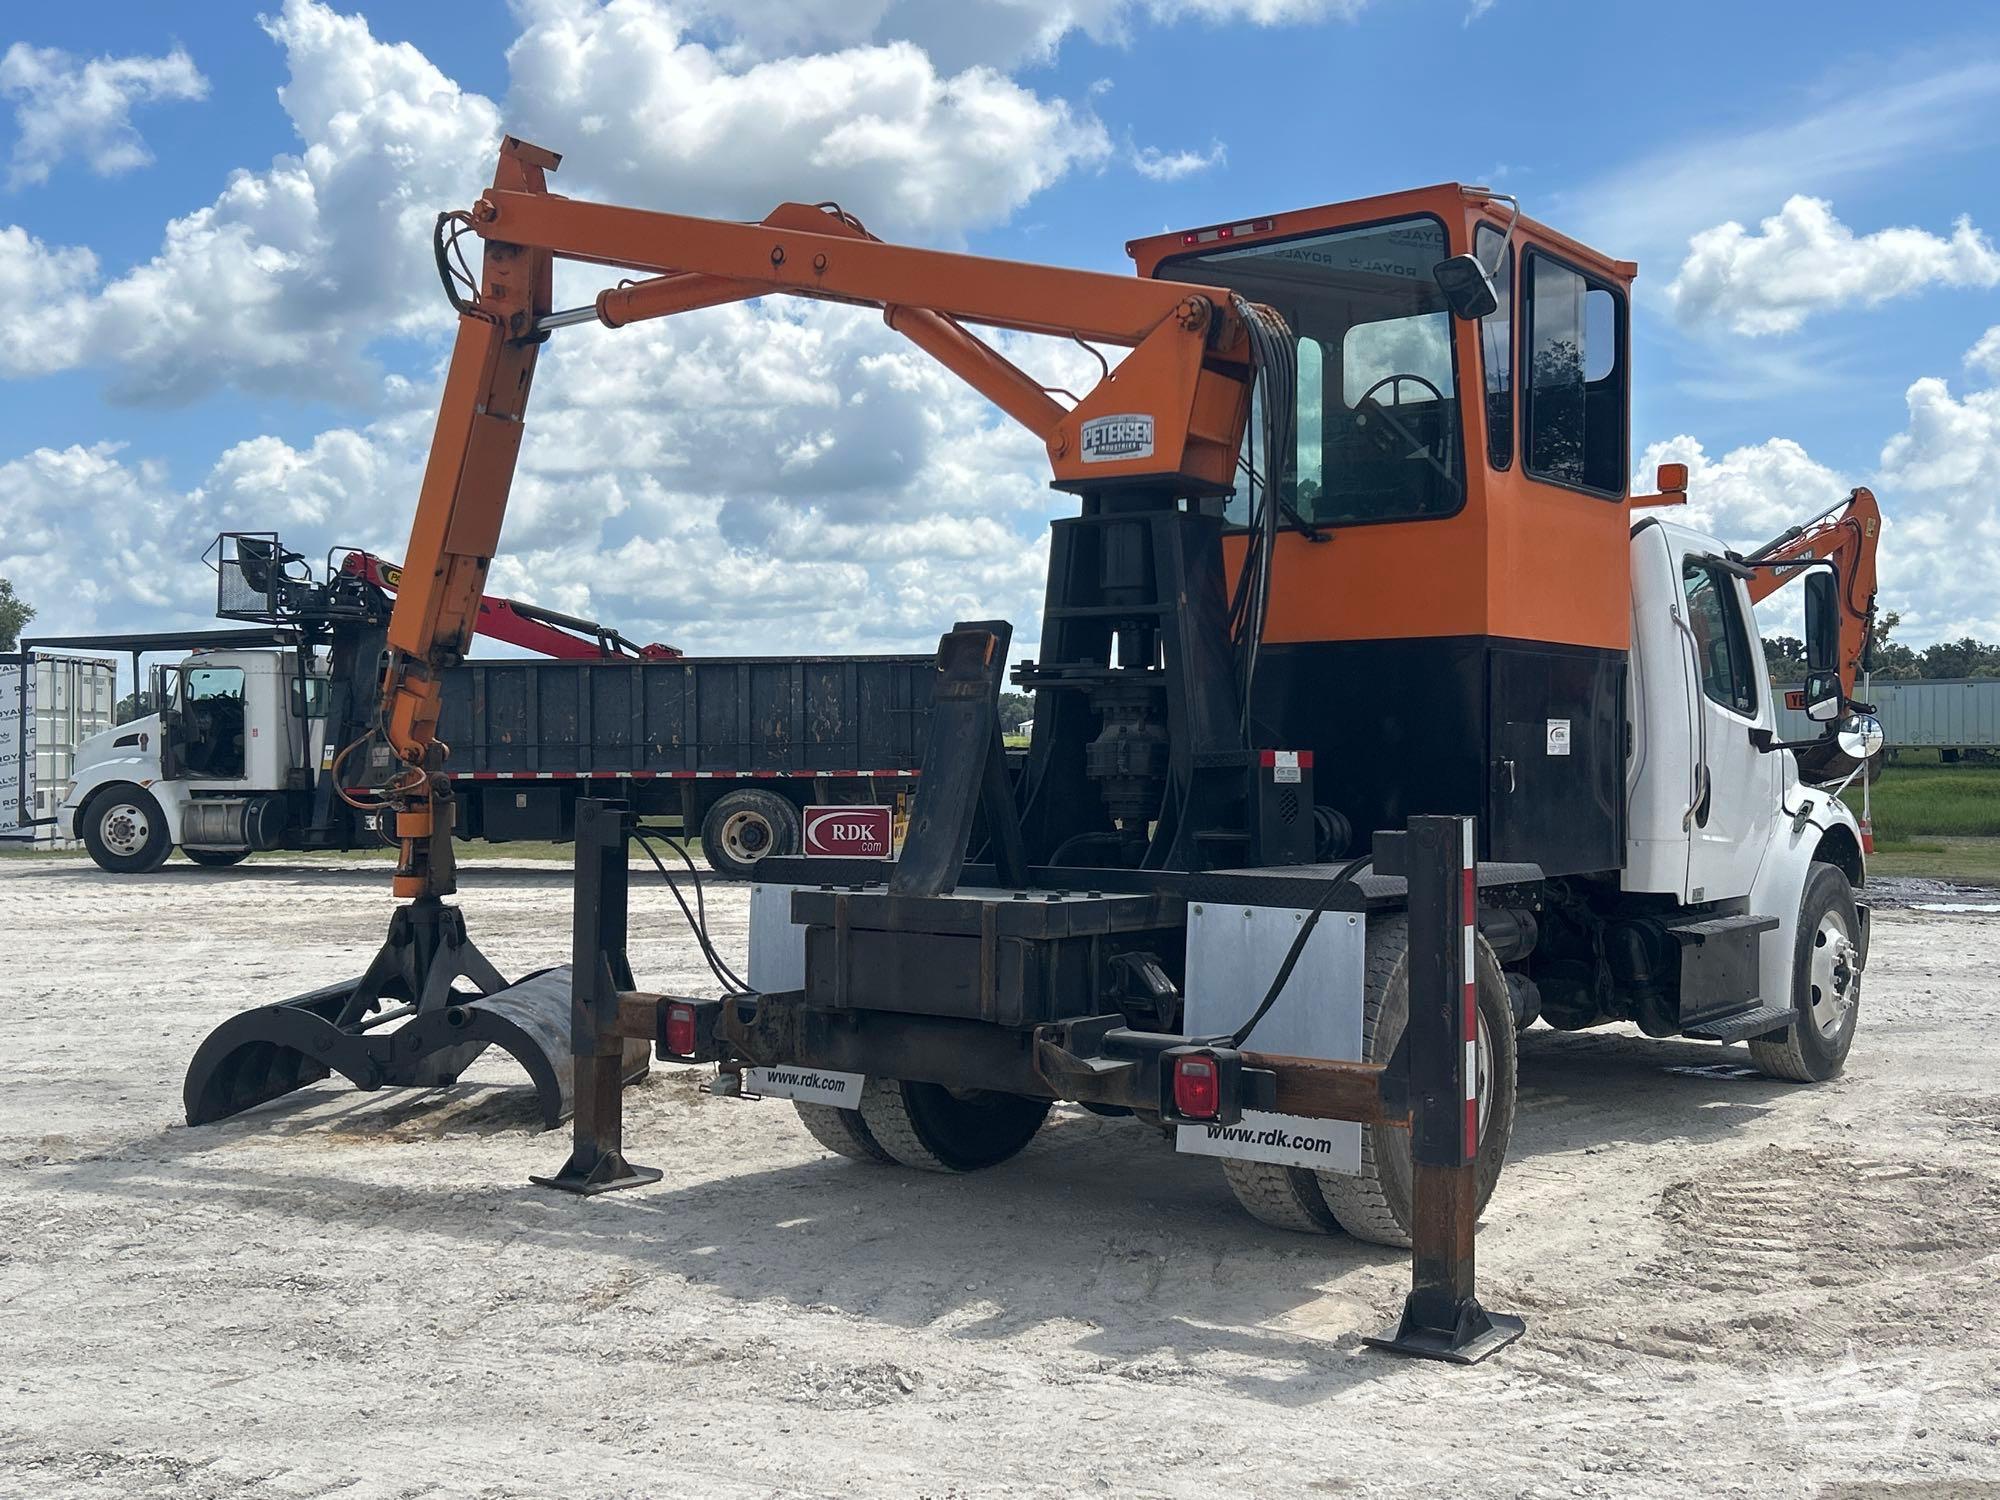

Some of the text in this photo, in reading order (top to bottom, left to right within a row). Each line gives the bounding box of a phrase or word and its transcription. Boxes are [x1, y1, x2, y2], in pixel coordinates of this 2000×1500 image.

[1083, 422, 1152, 449] PETERSEN
[831, 824, 875, 841] RDK
[858, 841, 882, 852] .com
[767, 1071, 845, 1093] www.rdk.com
[1207, 1126, 1331, 1154] www.rdk.com
